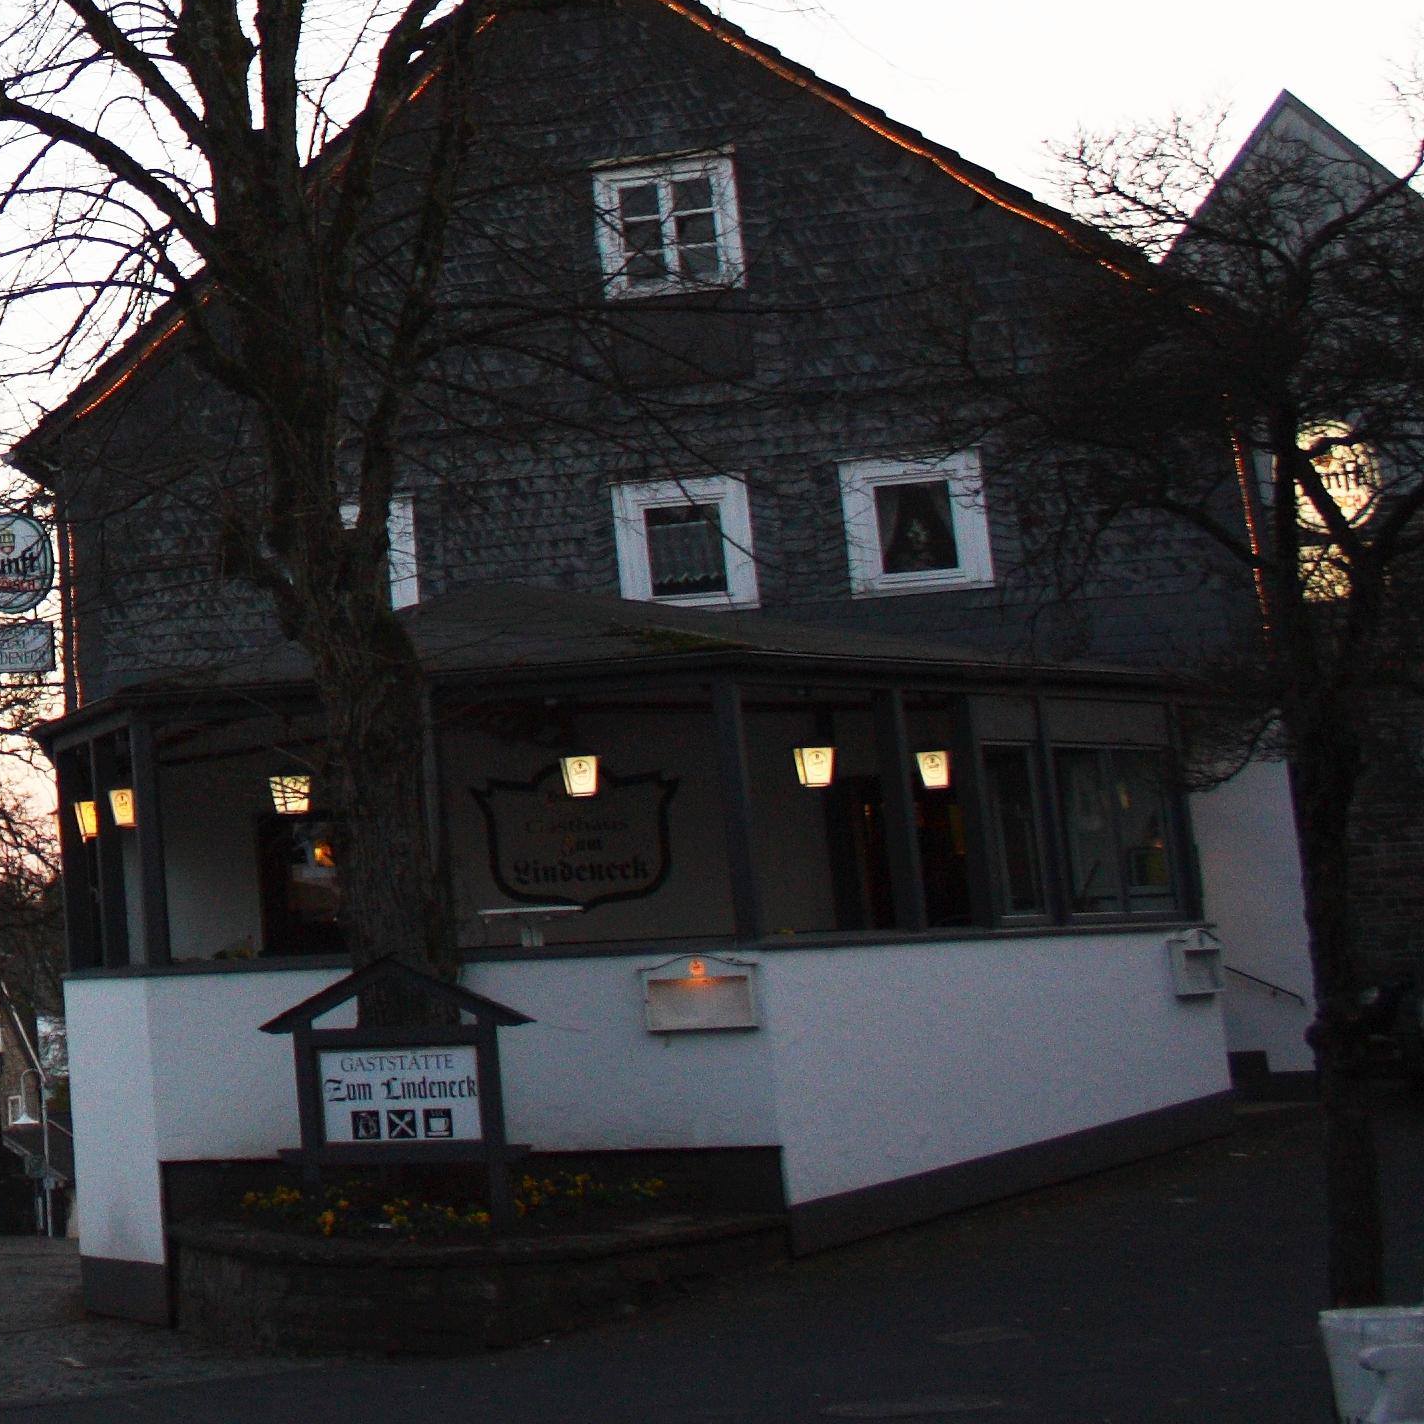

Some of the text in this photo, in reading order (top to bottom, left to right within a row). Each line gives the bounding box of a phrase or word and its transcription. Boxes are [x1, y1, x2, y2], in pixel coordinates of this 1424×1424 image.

[513, 855, 650, 885] Lindeneck
[340, 1051, 454, 1072] GASTSTÄTTE
[324, 1075, 479, 1102] Zum Lindeneck
